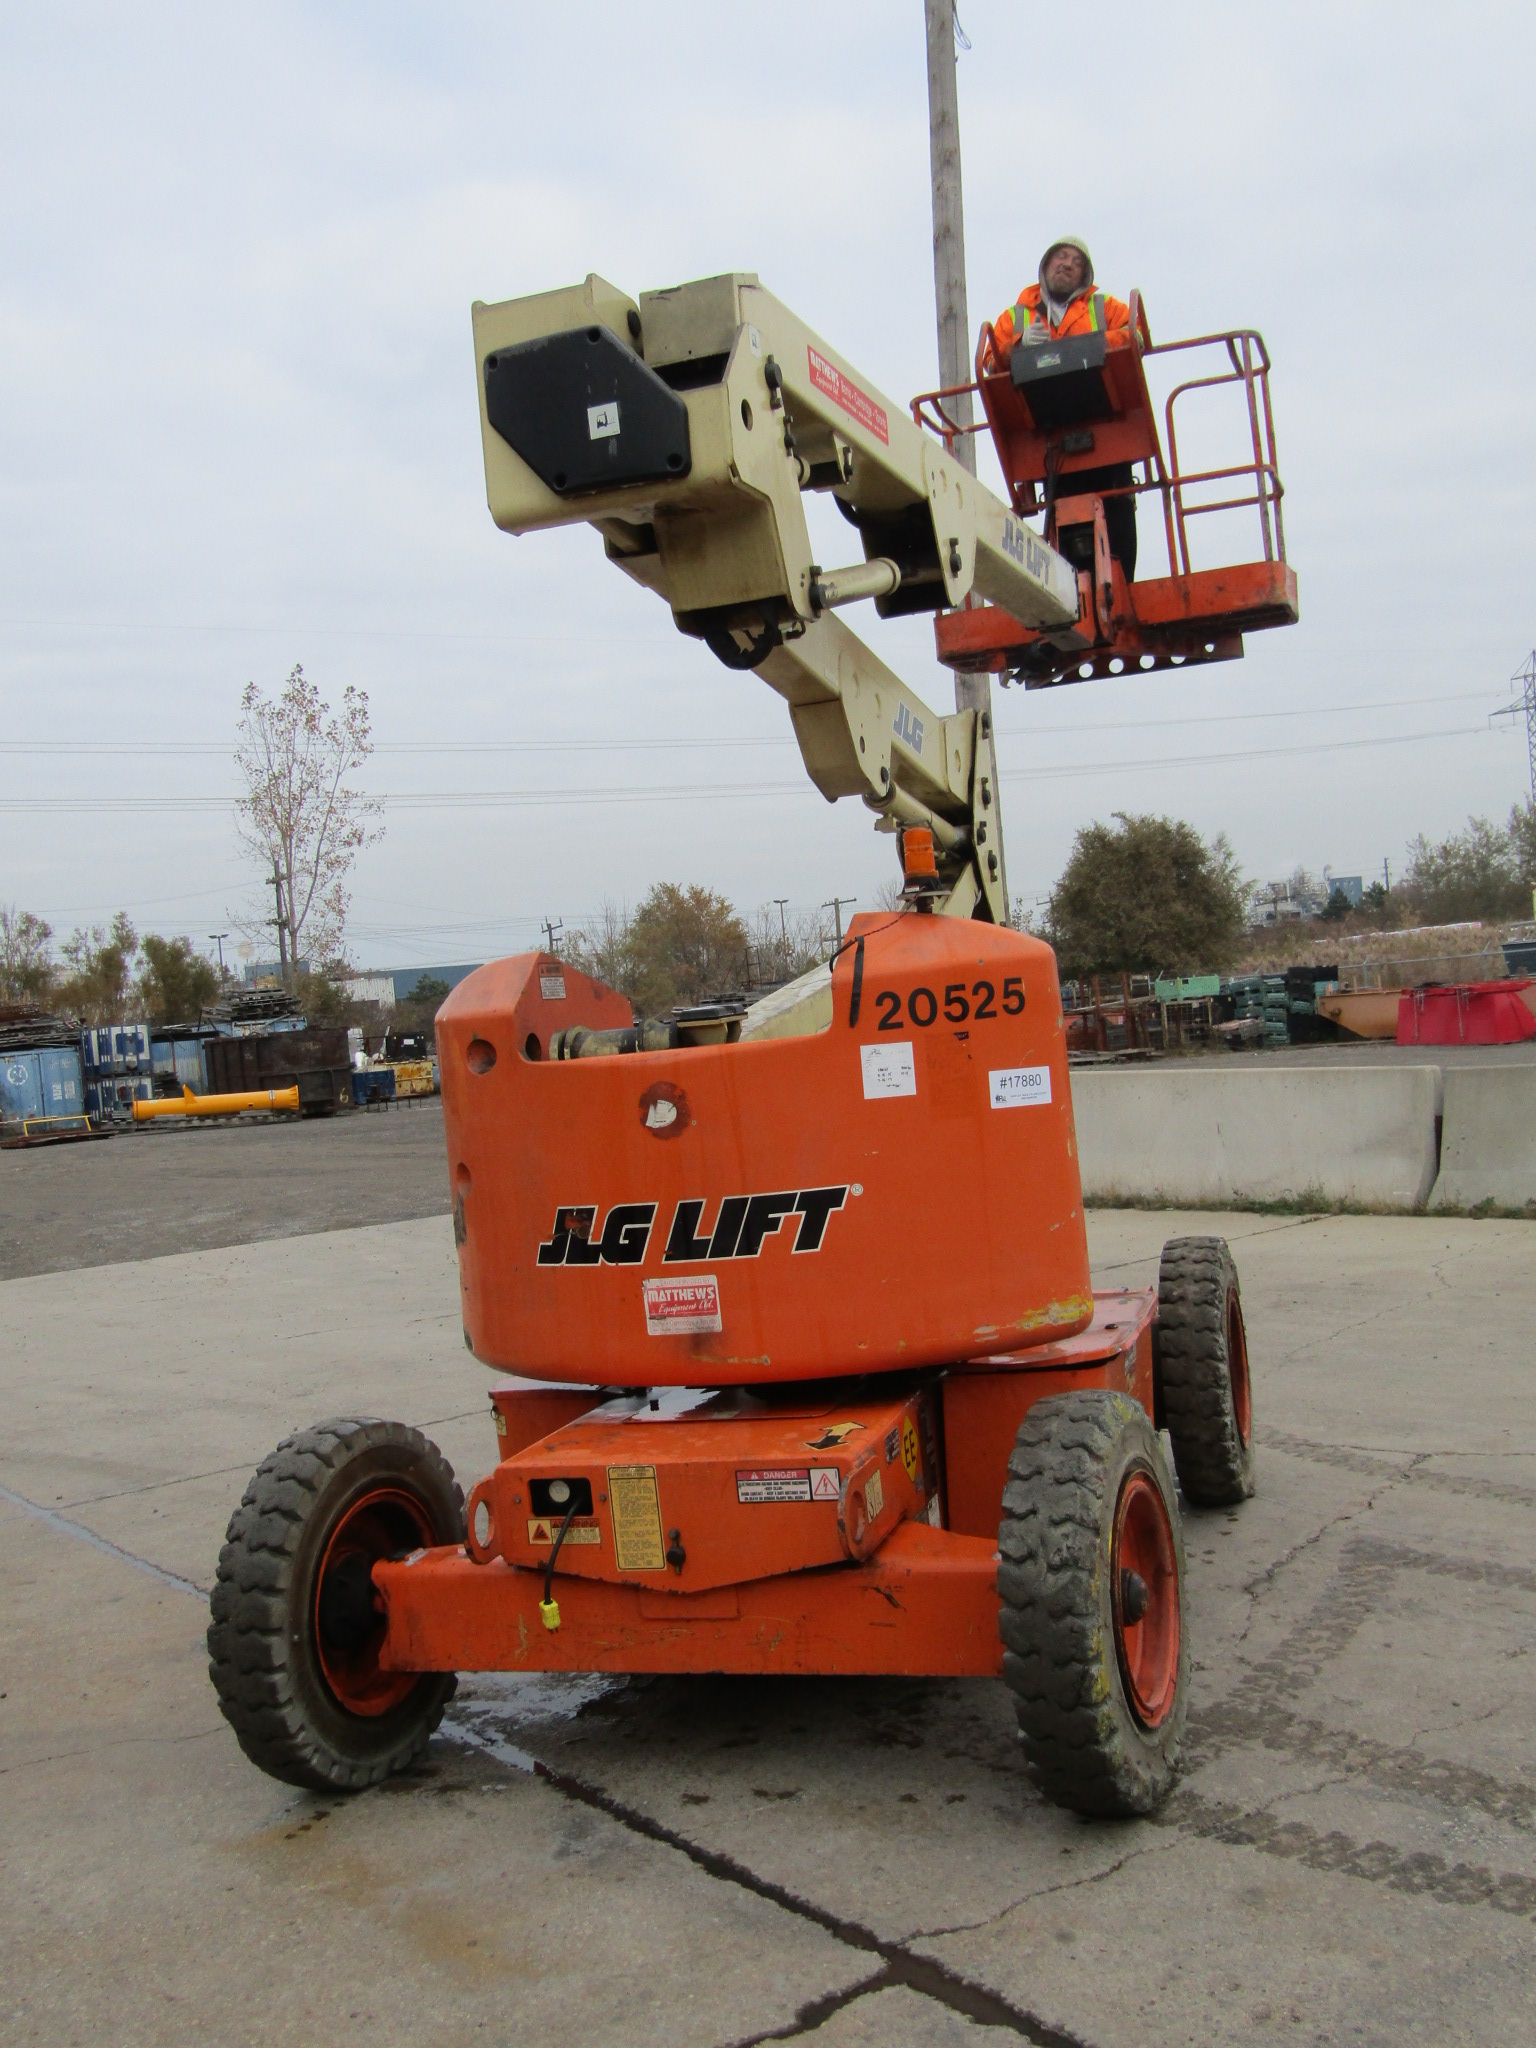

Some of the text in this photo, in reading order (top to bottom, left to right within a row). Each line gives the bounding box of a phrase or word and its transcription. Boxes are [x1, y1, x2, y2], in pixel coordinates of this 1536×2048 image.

[1001, 517, 1051, 586] JLG LIFT
[892, 700, 924, 755] JLG
[875, 977, 1026, 1031] 20525
[999, 1073, 1042, 1089] #17880
[536, 1202, 659, 1266] JLG
[661, 1184, 850, 1264] LIFT
[647, 1286, 716, 1303] MATTHEWS
[902, 1428, 917, 1469] EE
[763, 1471, 798, 1479] DANGER
